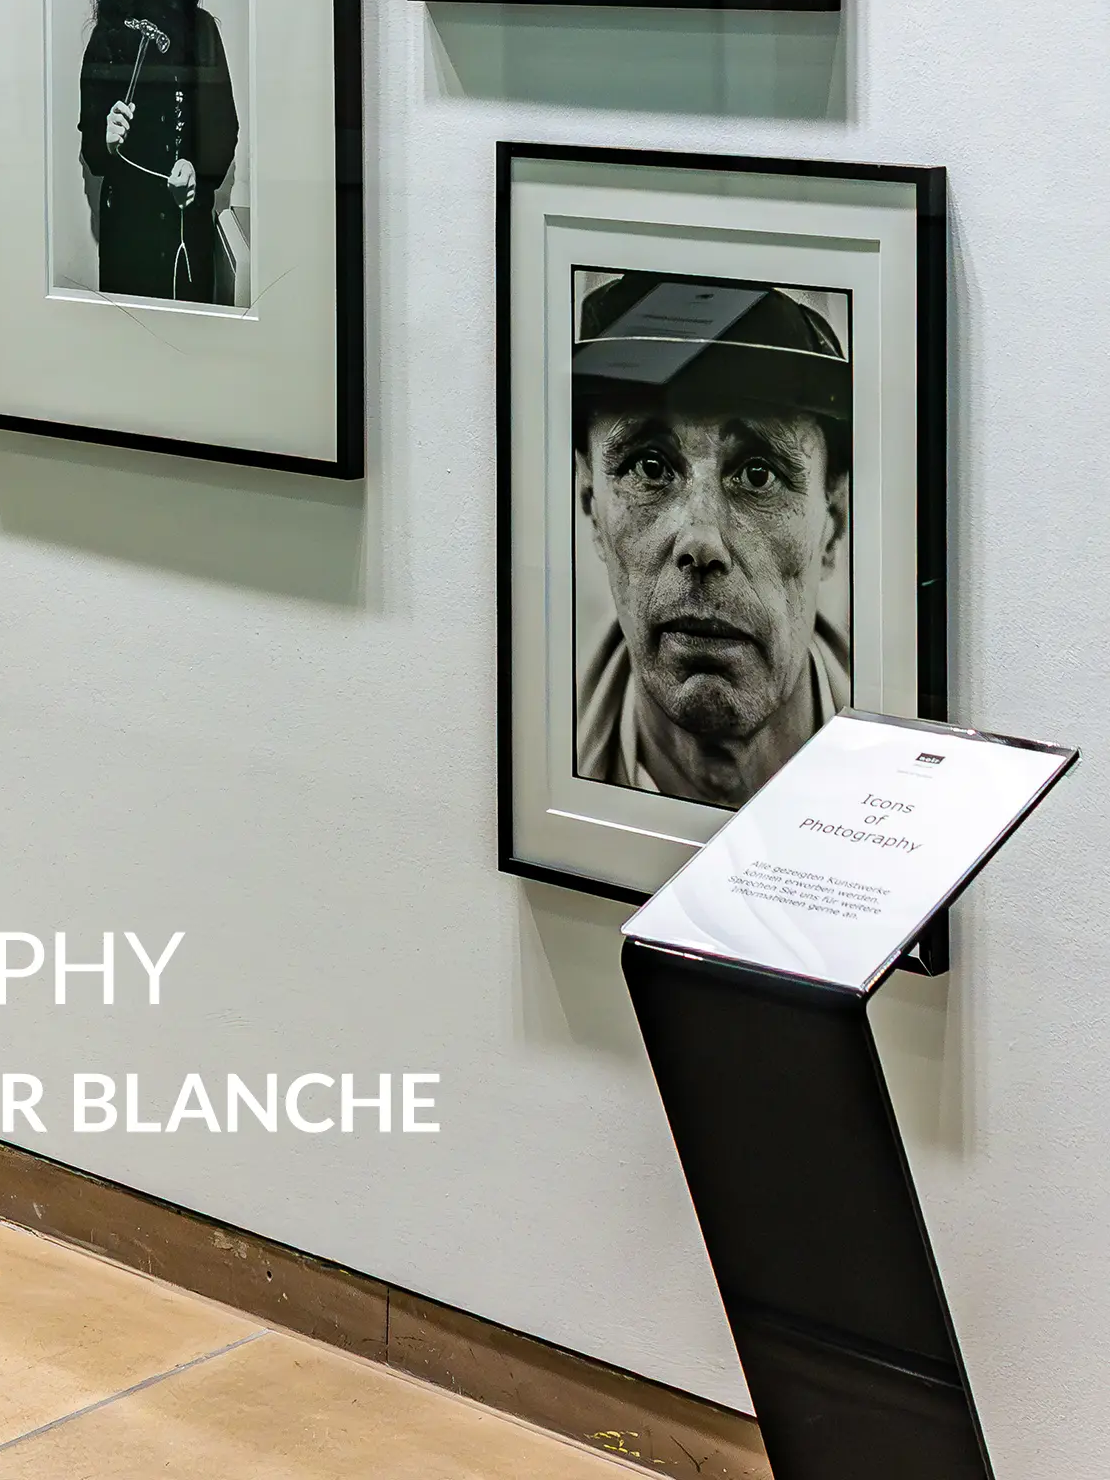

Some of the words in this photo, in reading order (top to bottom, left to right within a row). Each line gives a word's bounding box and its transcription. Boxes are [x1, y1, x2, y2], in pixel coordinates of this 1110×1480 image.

[861, 794, 915, 814] Icons
[864, 815, 889, 825] of
[799, 818, 924, 853] Photography
[750, 861, 771, 870] Alle
[772, 866, 824, 881] gezeigten
[827, 876, 891, 896] Kunstwerke
[784, 880, 834, 894] erworben
[728, 876, 777, 891] Sprechen
[779, 886, 797, 895] Sie
[799, 891, 820, 900] uns
[821, 896, 839, 904] für
[841, 902, 881, 914] weitere
[731, 886, 806, 907] Informationen
[807, 904, 840, 916] gerne
